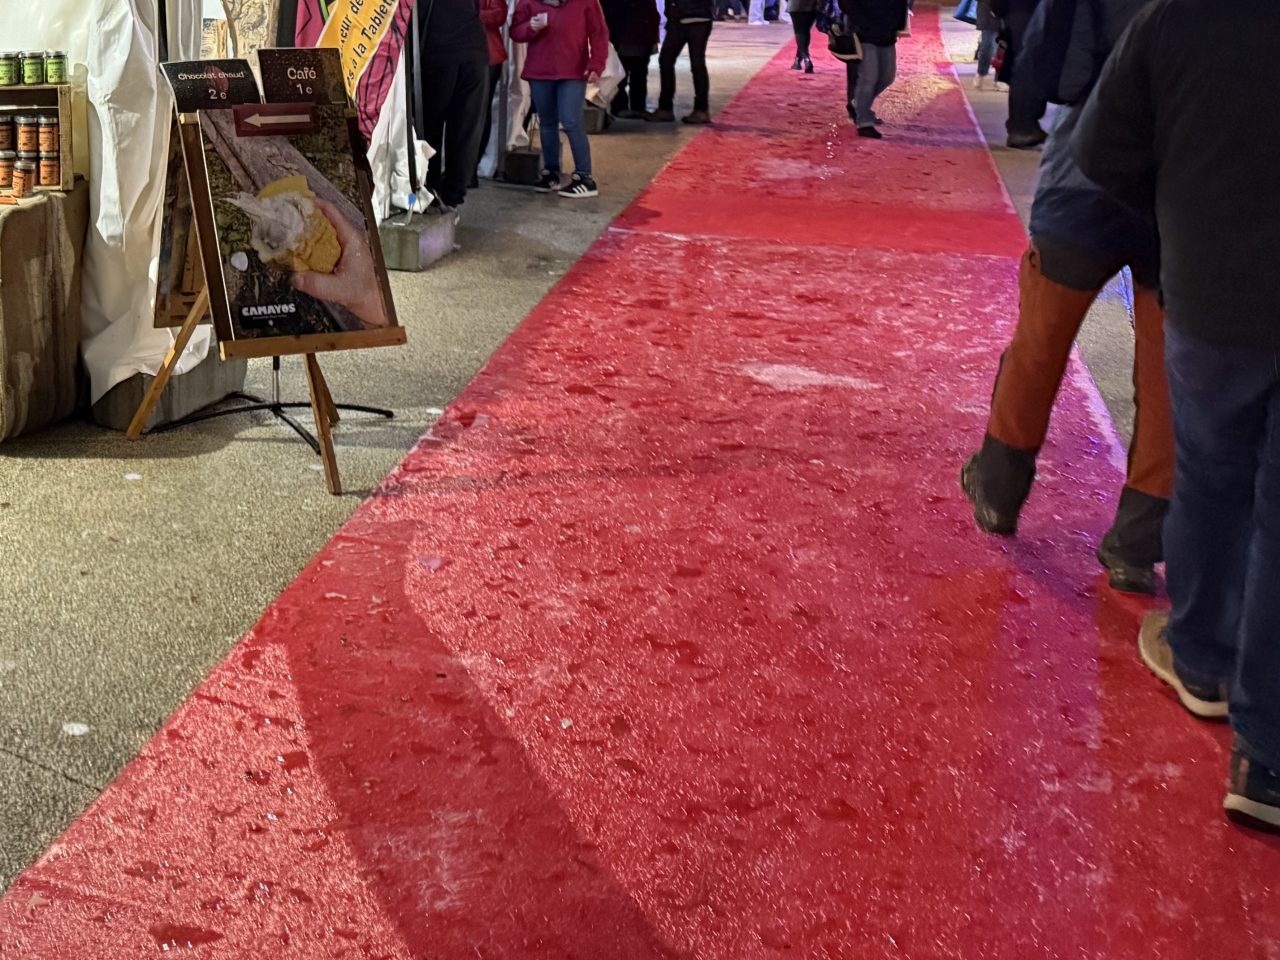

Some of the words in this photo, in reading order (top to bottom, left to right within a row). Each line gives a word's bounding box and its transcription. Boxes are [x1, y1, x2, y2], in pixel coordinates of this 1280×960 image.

[353, 43, 367, 58] la
[178, 72, 217, 81] Chocolat
[218, 71, 245, 79] chaud
[287, 66, 318, 80] Café
[208, 89, 218, 100] 2
[296, 83, 303, 95] 1
[242, 303, 296, 317] CAMAYOS
